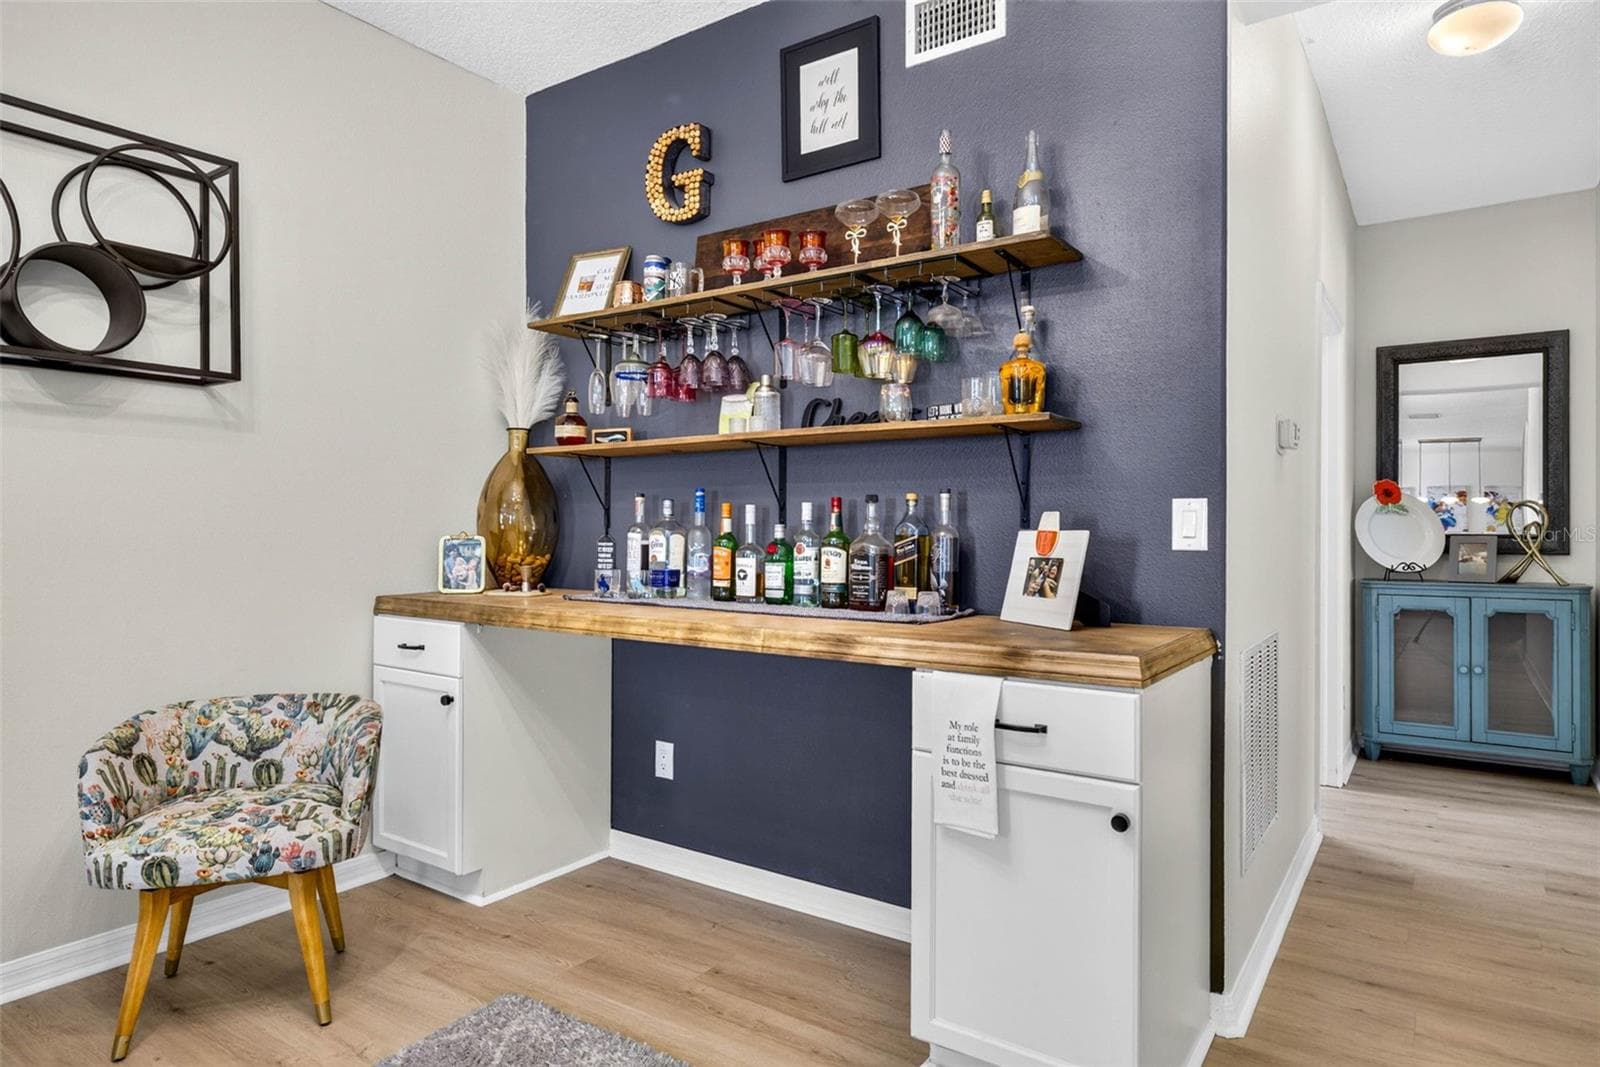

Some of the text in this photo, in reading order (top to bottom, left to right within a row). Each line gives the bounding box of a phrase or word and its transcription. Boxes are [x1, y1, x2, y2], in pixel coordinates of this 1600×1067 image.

[644, 122, 715, 225] G
[949, 720, 979, 733] My role
[957, 732, 980, 747] family
[946, 744, 982, 757] functions
[943, 755, 986, 770] is to be the
[941, 766, 989, 783] best dressed
[941, 780, 956, 790] and
